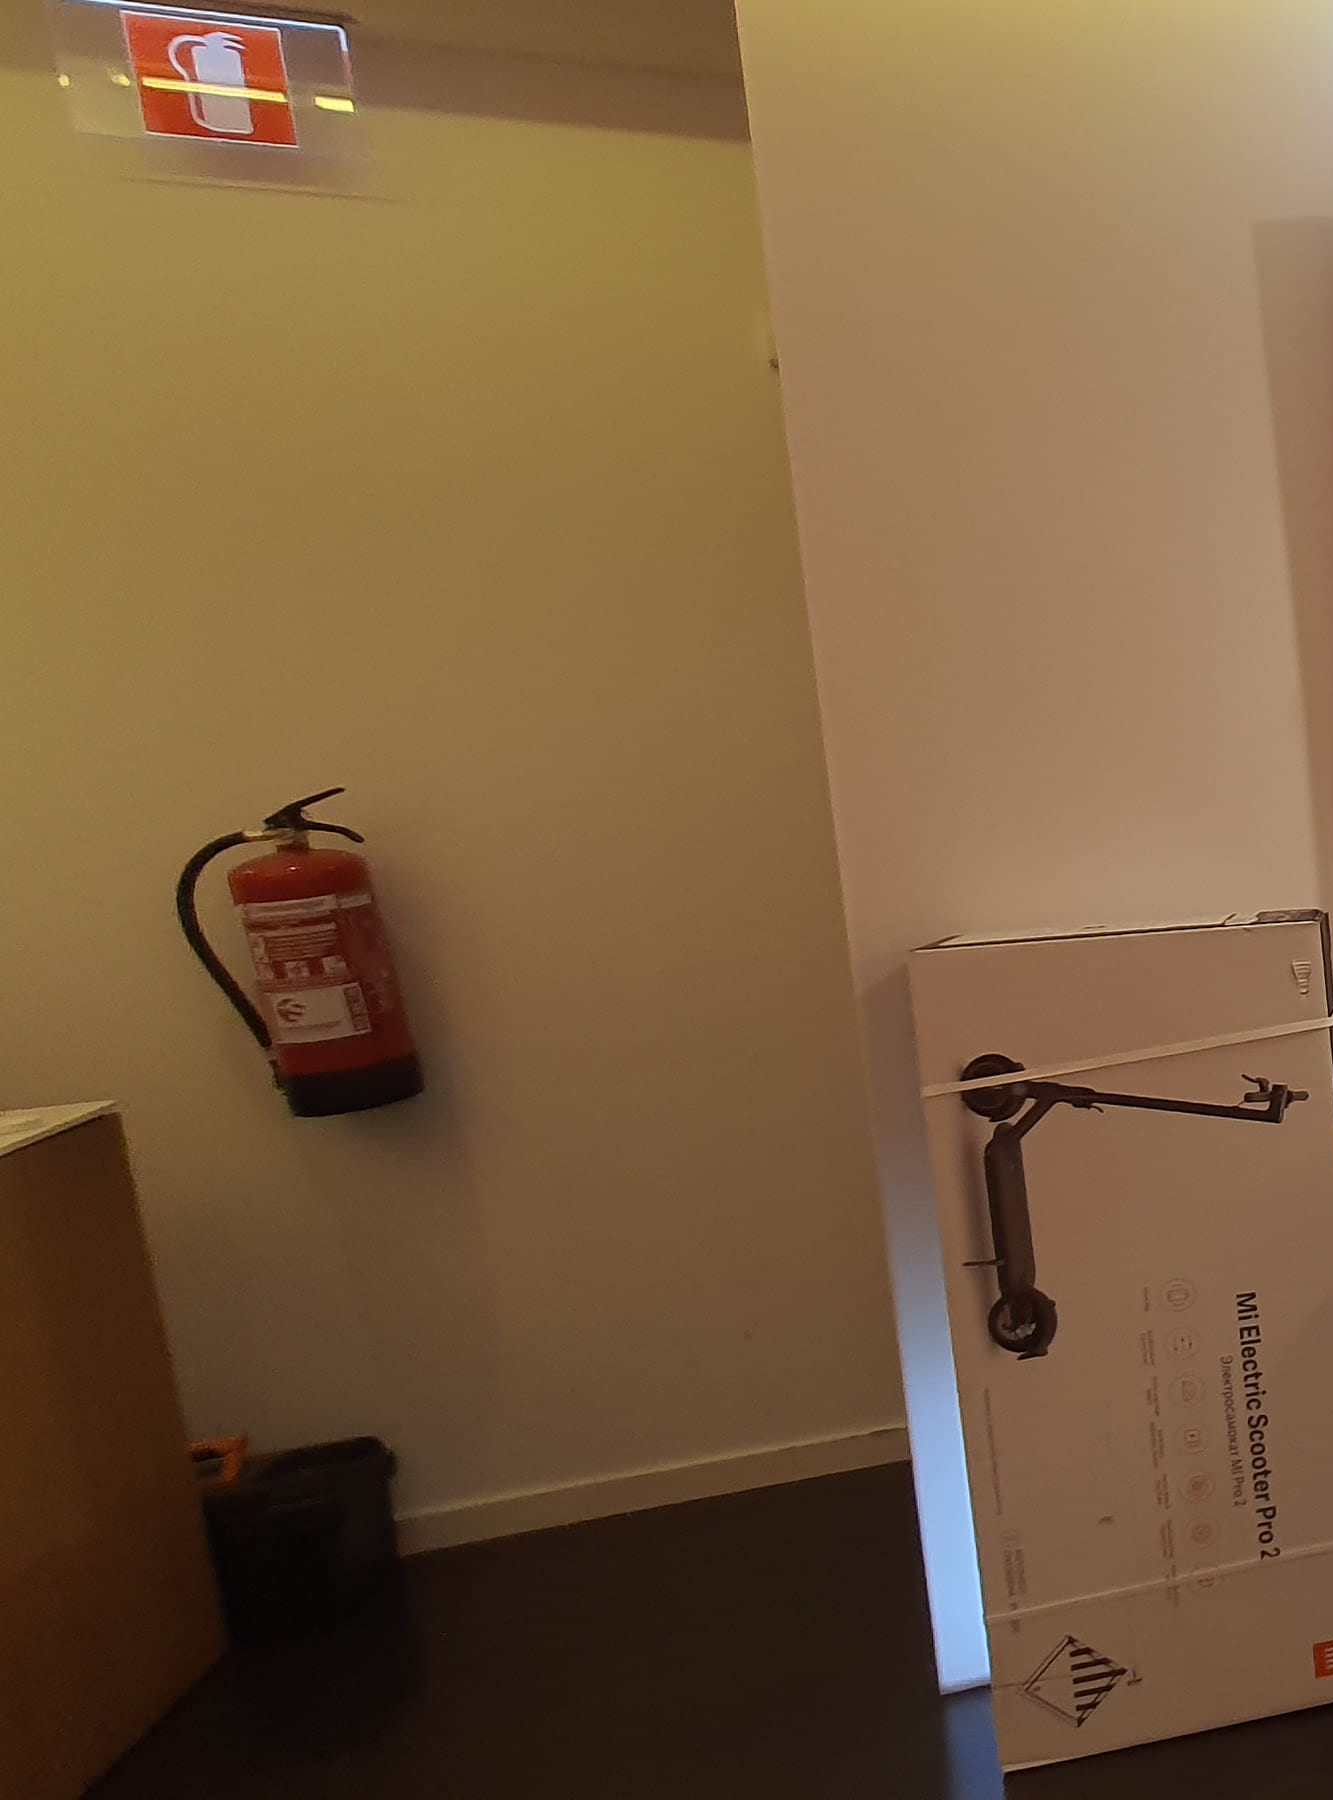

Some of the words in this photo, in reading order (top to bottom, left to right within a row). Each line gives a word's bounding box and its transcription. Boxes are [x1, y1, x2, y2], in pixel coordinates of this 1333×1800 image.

[1236, 1292, 1260, 1321] Mi
[1239, 1325, 1267, 1411] Electric
[1247, 1413, 1273, 1502] Scooter
[1232, 1475, 1245, 1499] Pro
[1255, 1505, 1277, 1544] Pro
[1260, 1546, 1281, 1560] 2
